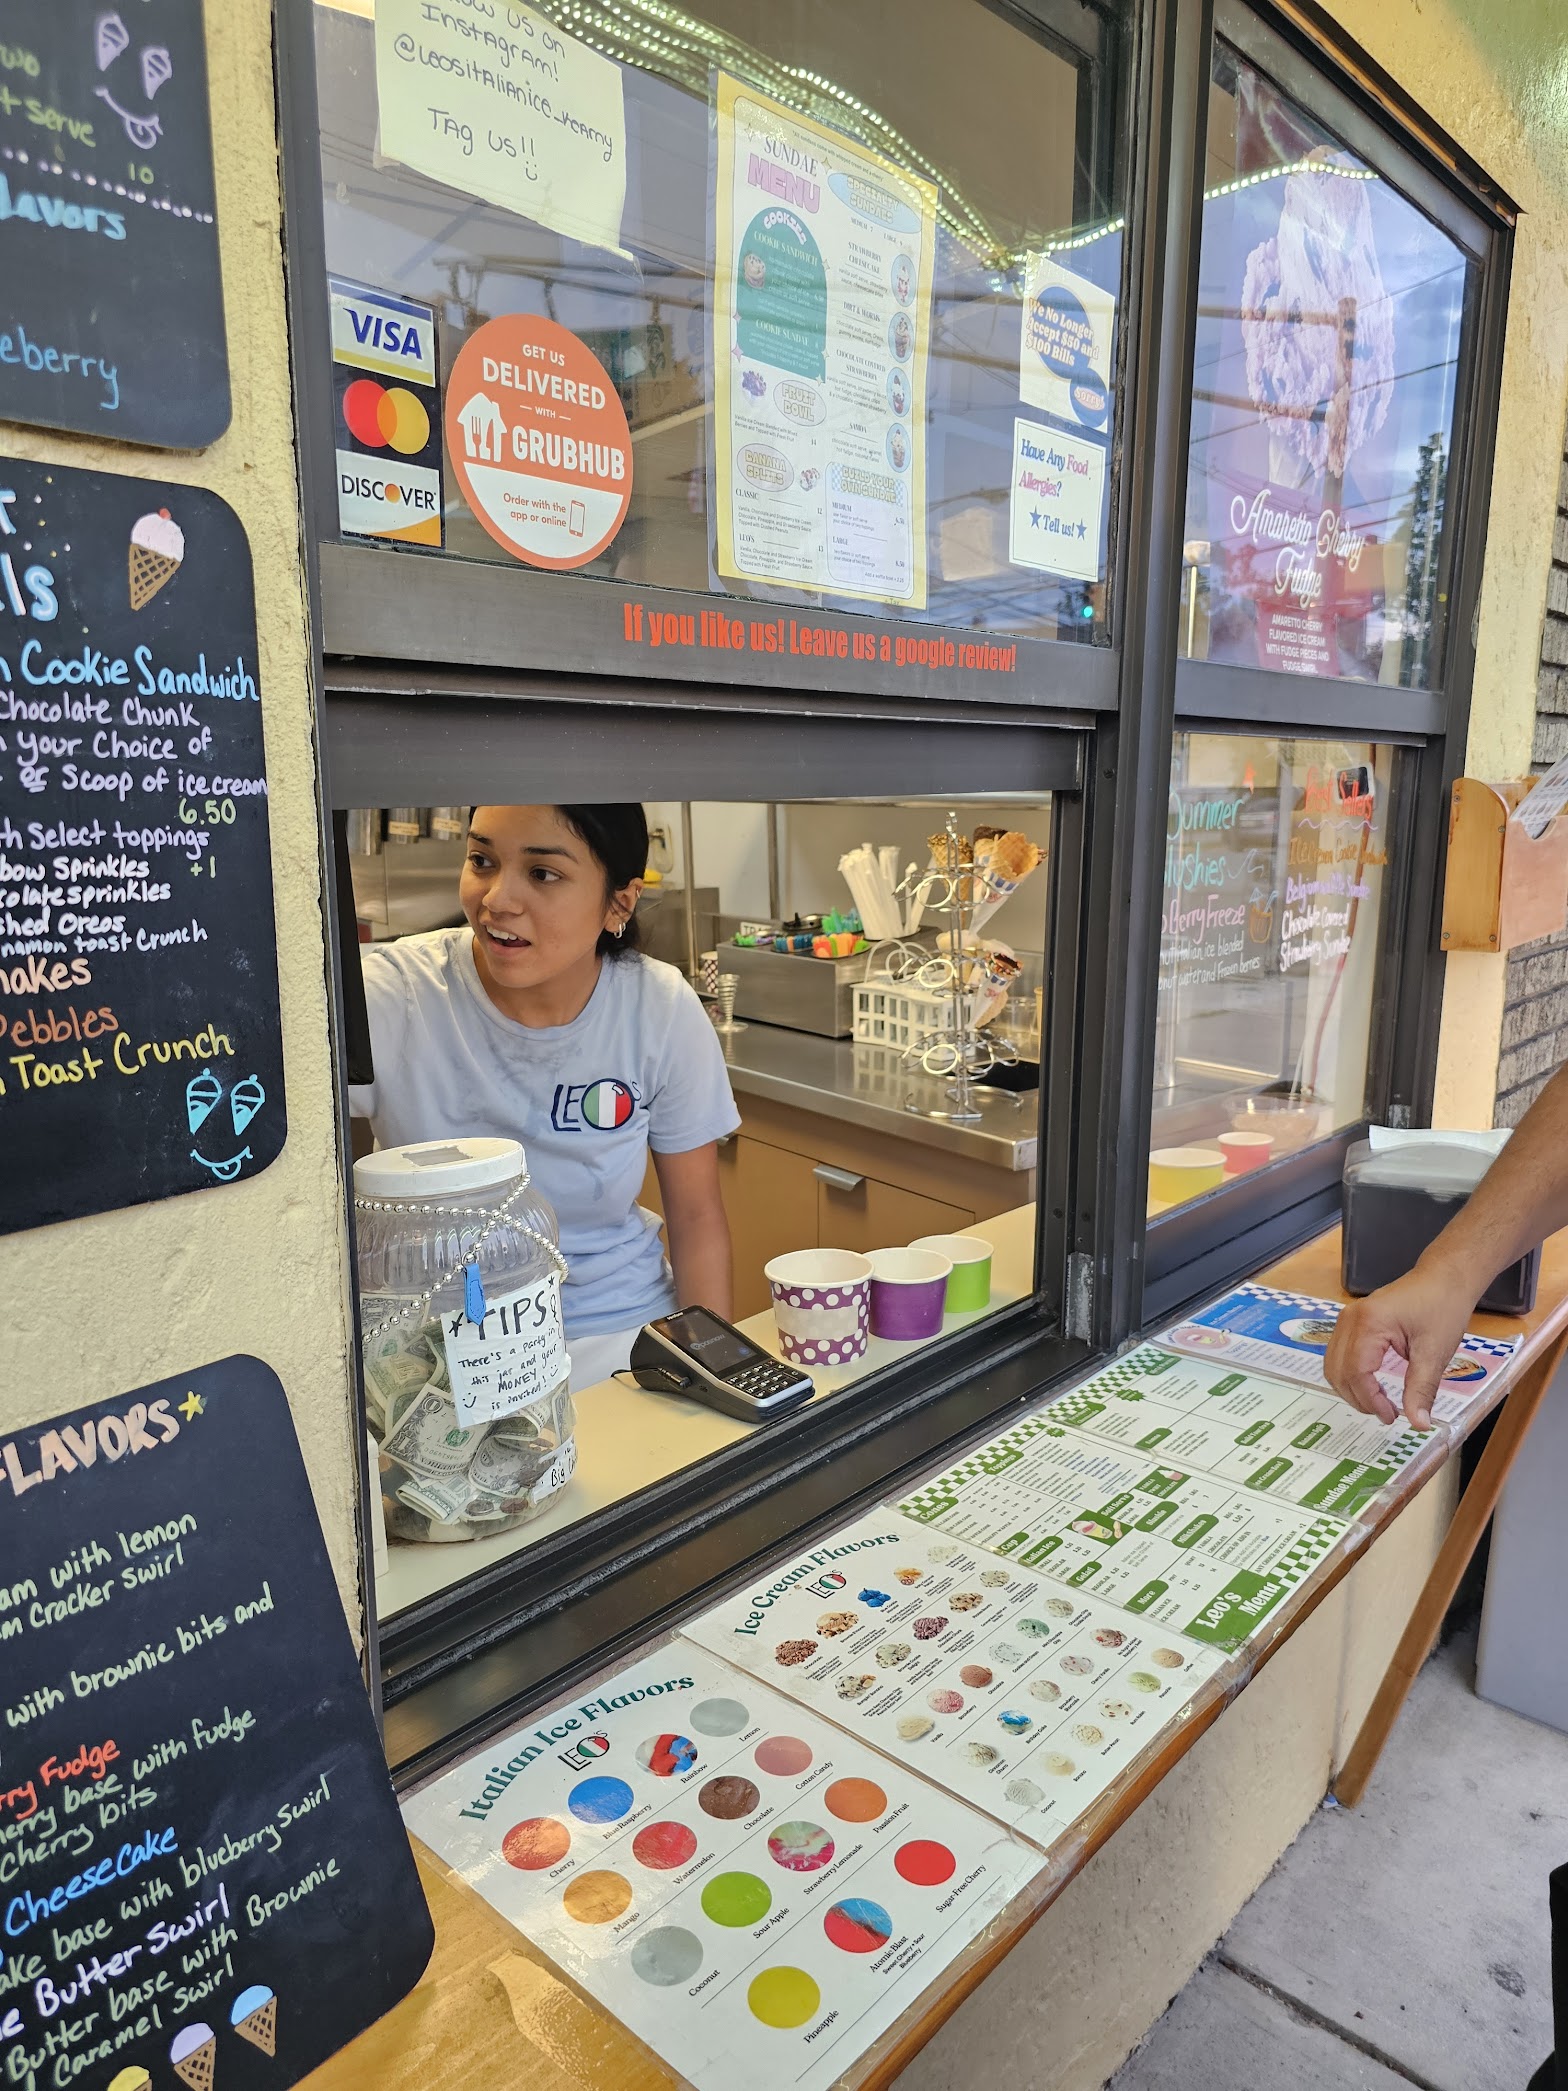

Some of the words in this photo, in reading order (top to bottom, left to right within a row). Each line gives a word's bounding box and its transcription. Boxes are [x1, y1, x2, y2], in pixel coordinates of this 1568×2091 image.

[26, 100, 96, 148] serve
[128, 163, 155, 185] 10
[764, 136, 818, 177] SUNDAE
[748, 153, 821, 214] MENU
[343, 307, 423, 360] VISA
[1029, 297, 1045, 317] We
[1045, 304, 1059, 325] No
[1060, 313, 1094, 341] Longer
[522, 343, 546, 361] GET
[549, 351, 565, 367] US
[1025, 332, 1050, 356] $100
[1051, 343, 1075, 367] Bills
[1026, 316, 1061, 342] Accept
[1061, 331, 1080, 352] $50
[1081, 344, 1100, 361] and
[482, 357, 606, 410] DELIVERED
[535, 406, 556, 419] WITH
[512, 425, 625, 481] GRUBHUB
[1021, 438, 1045, 462] Have
[1047, 448, 1065, 472] Any
[1066, 454, 1088, 476] Food
[341, 474, 437, 511] DISCOVER
[503, 492, 530, 507] Order
[532, 498, 550, 511] with
[552, 501, 567, 513] the
[1019, 470, 1062, 497] Allergies?
[510, 509, 528, 523] app
[530, 514, 540, 523] or
[541, 513, 567, 528] online
[1043, 515, 1060, 534] Tell
[1062, 523, 1075, 537] us!
[1230, 489, 1312, 543] Amaretto
[1316, 509, 1364, 572] Cherry
[1275, 547, 1322, 608] Fudge
[623, 603, 643, 642] If
[648, 611, 695, 647] you
[700, 610, 745, 651] like
[750, 619, 785, 653] us!
[789, 620, 848, 659] Leave
[852, 634, 876, 663] us
[880, 635, 891, 663] a
[895, 636, 955, 670] google
[958, 641, 1017, 672] review!
[20, 639, 131, 686] Cookie
[133, 645, 260, 701] Sandwich
[0, 690, 112, 723] Chocolate
[123, 697, 200, 727] Chunk
[17, 730, 83, 767] your
[93, 731, 178, 760] Choice
[188, 726, 213, 755] of
[142, 769, 168, 792] of
[179, 798, 236, 825] 6.50
[28, 819, 107, 851] Select
[113, 821, 210, 860] toppings
[58, 912, 126, 936] Oreos
[74, 931, 132, 953] toast
[136, 919, 208, 951] Crunch
[10, 1047, 104, 1089] Toast
[114, 1023, 236, 1074] Crunch
[458, 1350, 502, 1368] There's
[522, 1335, 545, 1353] party
[548, 1327, 555, 1337] in
[471, 1375, 489, 1385] this
[497, 1367, 513, 1380] jar
[520, 1354, 536, 1369] and
[541, 1343, 557, 1369] your
[498, 1368, 537, 1393] MONEY
[492, 1401, 500, 1410] is
[0, 1398, 181, 1496] LAVORS
[1313, 1483, 1347, 1511] Sundae
[1342, 1464, 1370, 1487] Menu
[920, 1501, 949, 1520] Cones
[50, 1540, 112, 1588] with
[119, 1513, 197, 1559] lemon
[1001, 1538, 1019, 1552] Cup
[30, 1579, 115, 1628] Cracker
[734, 1610, 765, 1636] Ice
[752, 1565, 816, 1608] Cream
[808, 1534, 900, 1567] Flavors
[1137, 1589, 1156, 1605] More
[1238, 1582, 1281, 1617] Menu
[1195, 1592, 1242, 1629] Leo's
[6, 1686, 64, 1727] with
[71, 1641, 174, 1697] brownie
[177, 1614, 227, 1654] bits
[234, 1581, 274, 1624] and
[459, 1743, 544, 1820] Italian
[534, 1718, 582, 1746] Ice
[578, 1675, 695, 1722] Flavors
[739, 1726, 761, 1742] Lemon
[40, 1738, 121, 1787] Fudge
[65, 1773, 123, 1814] base
[133, 1738, 187, 1781] with
[193, 1706, 256, 1750] fudge
[680, 1763, 708, 1784] Rainbow
[795, 1771, 818, 1791] Cotton
[813, 1760, 834, 1781] Candy
[100, 1788, 158, 1829] bits
[602, 1822, 621, 1840] Blue
[618, 1803, 652, 1830] Raspberry
[743, 1806, 775, 1831] Chocolate
[873, 1813, 900, 1834] Passion
[893, 1802, 910, 1819] Fruit
[549, 1858, 575, 1879] Cherry
[672, 1852, 716, 1885] Watermelon
[803, 1867, 837, 1896] Strawberry
[833, 1843, 863, 1870] Lemonade
[54, 1917, 113, 1961] base
[121, 1881, 173, 1921] with
[180, 1823, 283, 1890] blueberry
[935, 1882, 967, 1914] Sugar-Free
[964, 1864, 987, 1887] Cherry
[613, 1912, 640, 1933] Mango
[752, 1922, 771, 1939] Sour
[769, 1907, 790, 1926] Apple
[7, 2010, 100, 2082] Butter
[108, 1970, 175, 2022] base
[183, 1926, 239, 1975] with
[246, 1856, 341, 1928] Brownie
[869, 1951, 892, 1973] Atomic
[890, 1935, 909, 1953] Blast
[899, 1948, 922, 1969] Blueberry
[35, 1944, 143, 2017] Butter
[688, 1969, 720, 1997] Coconut
[803, 2009, 839, 2044] Pineapple
[55, 2010, 162, 2087] Caramel
